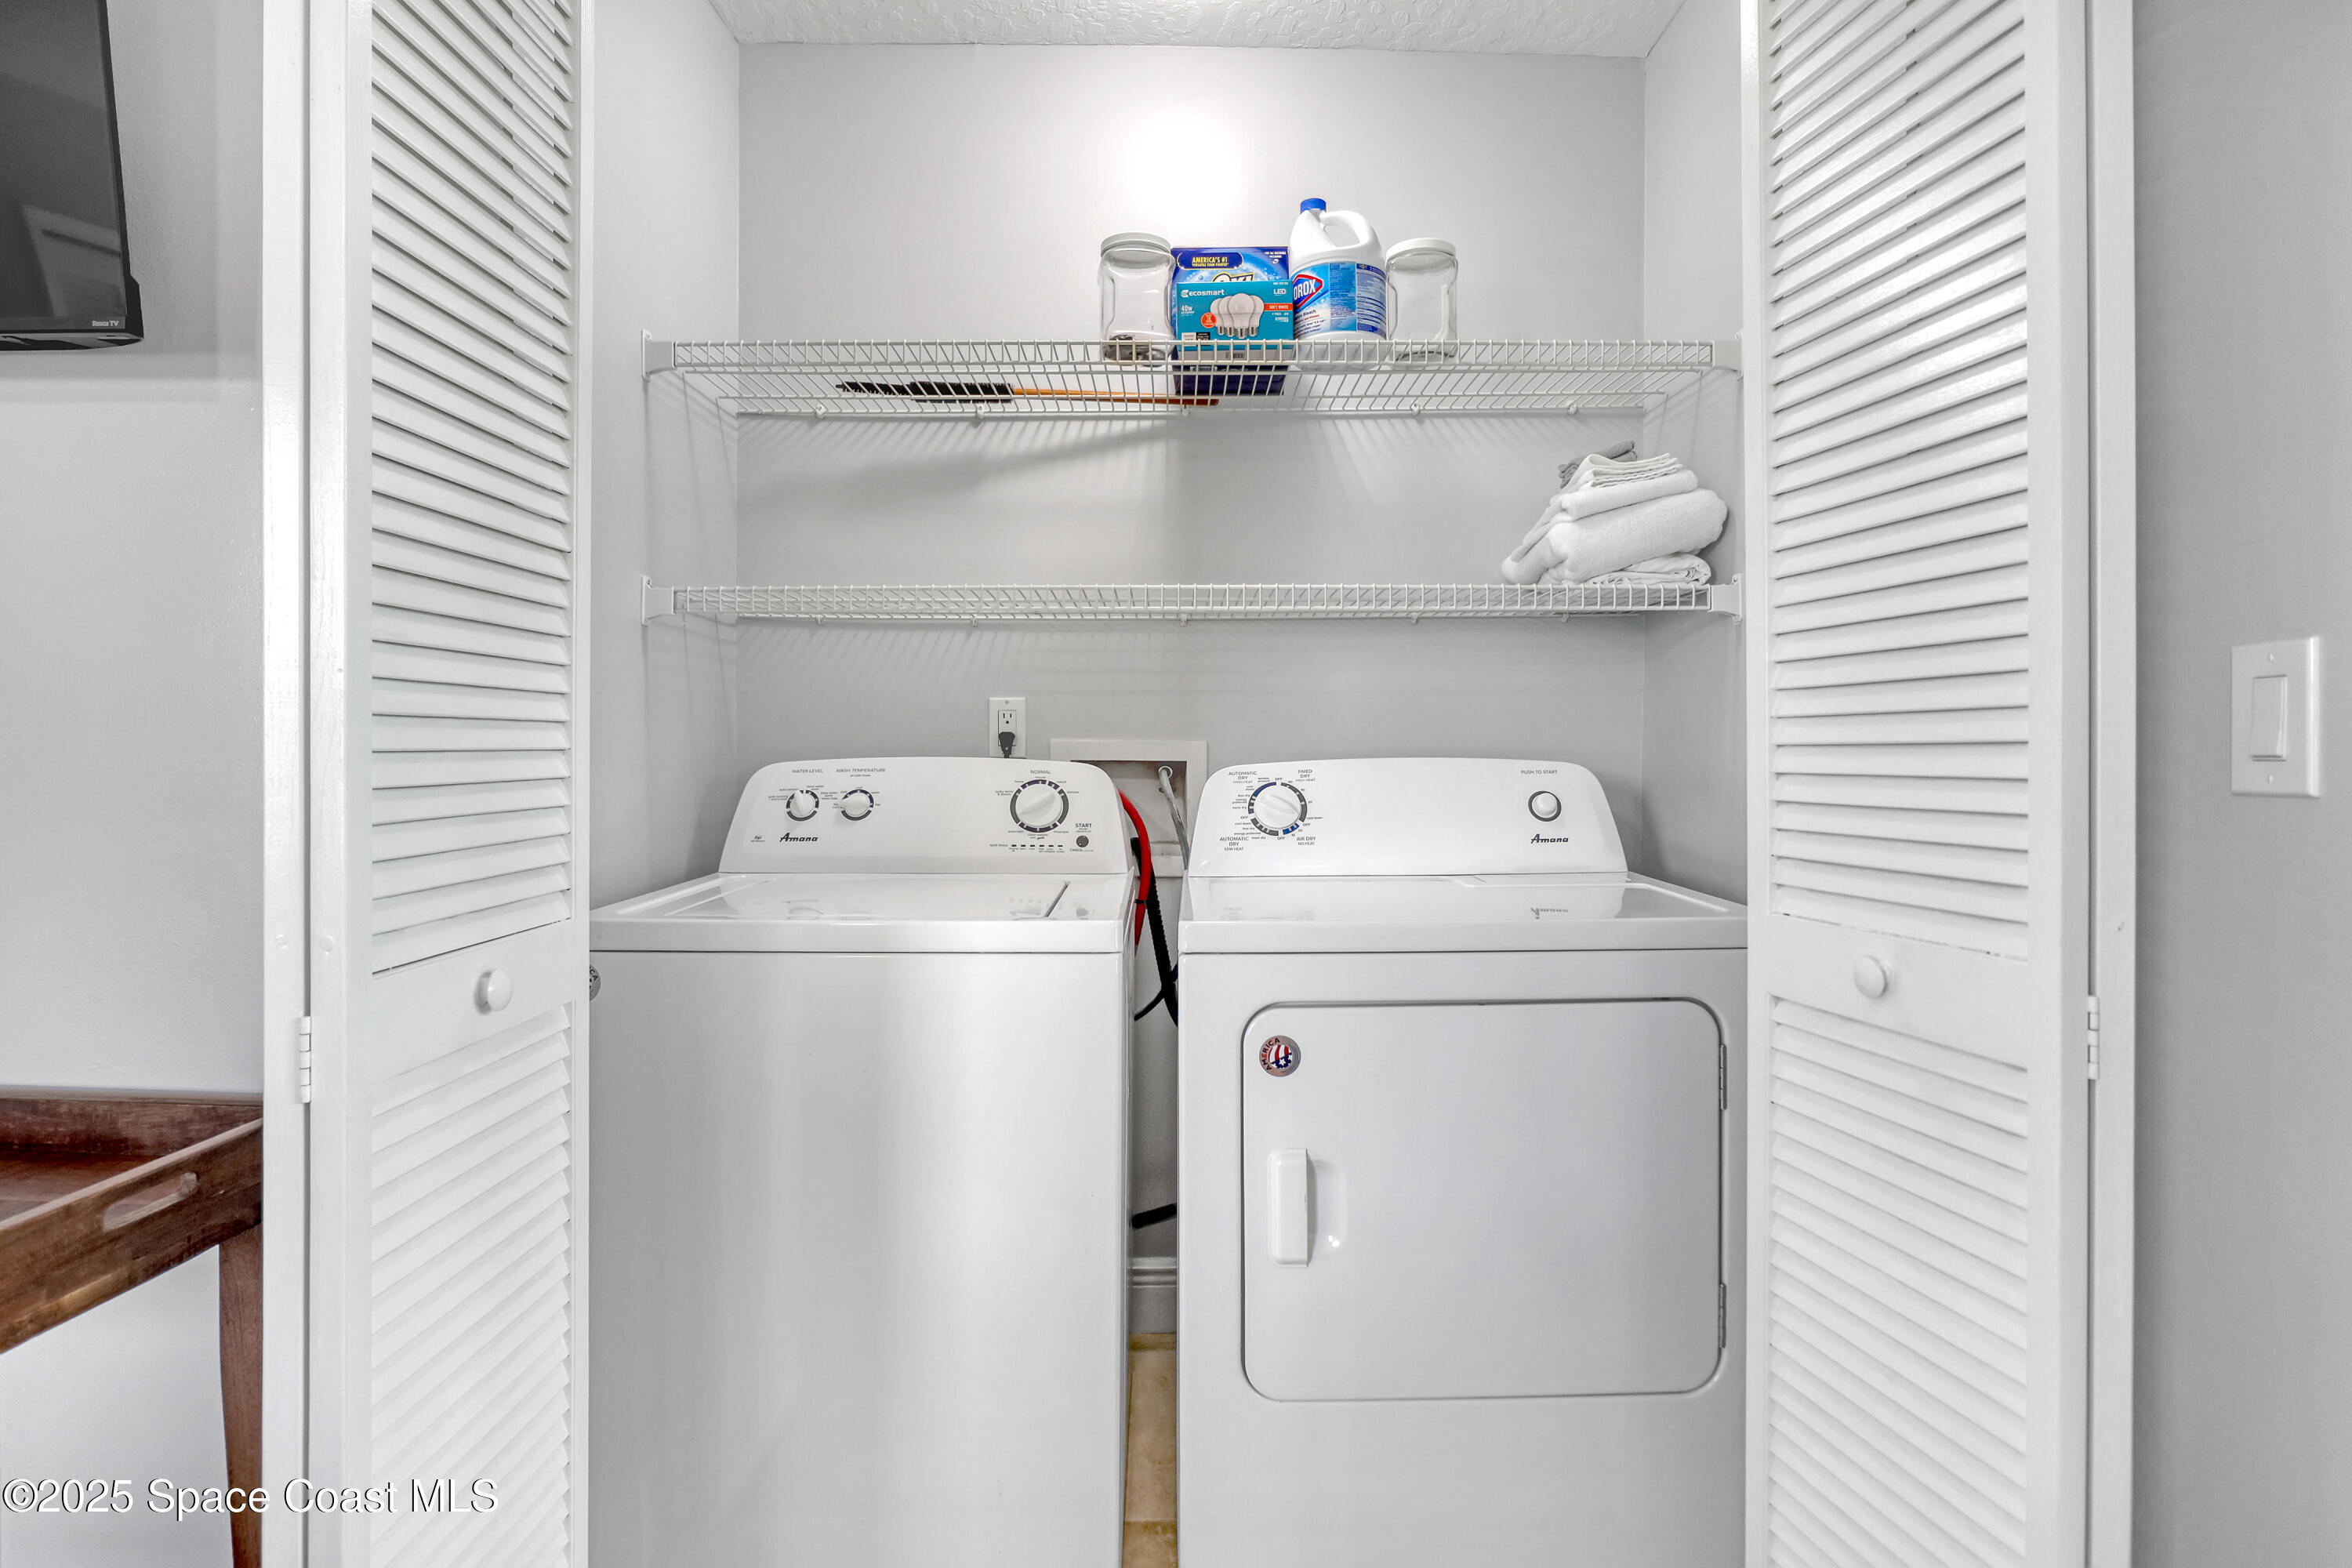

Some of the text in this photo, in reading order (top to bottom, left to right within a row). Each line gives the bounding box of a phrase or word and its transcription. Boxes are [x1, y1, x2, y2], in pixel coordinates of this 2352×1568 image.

[779, 833, 818, 843] Amana
[1531, 834, 1569, 844] Amana
[1261, 1038, 1280, 1070] AMERICA
